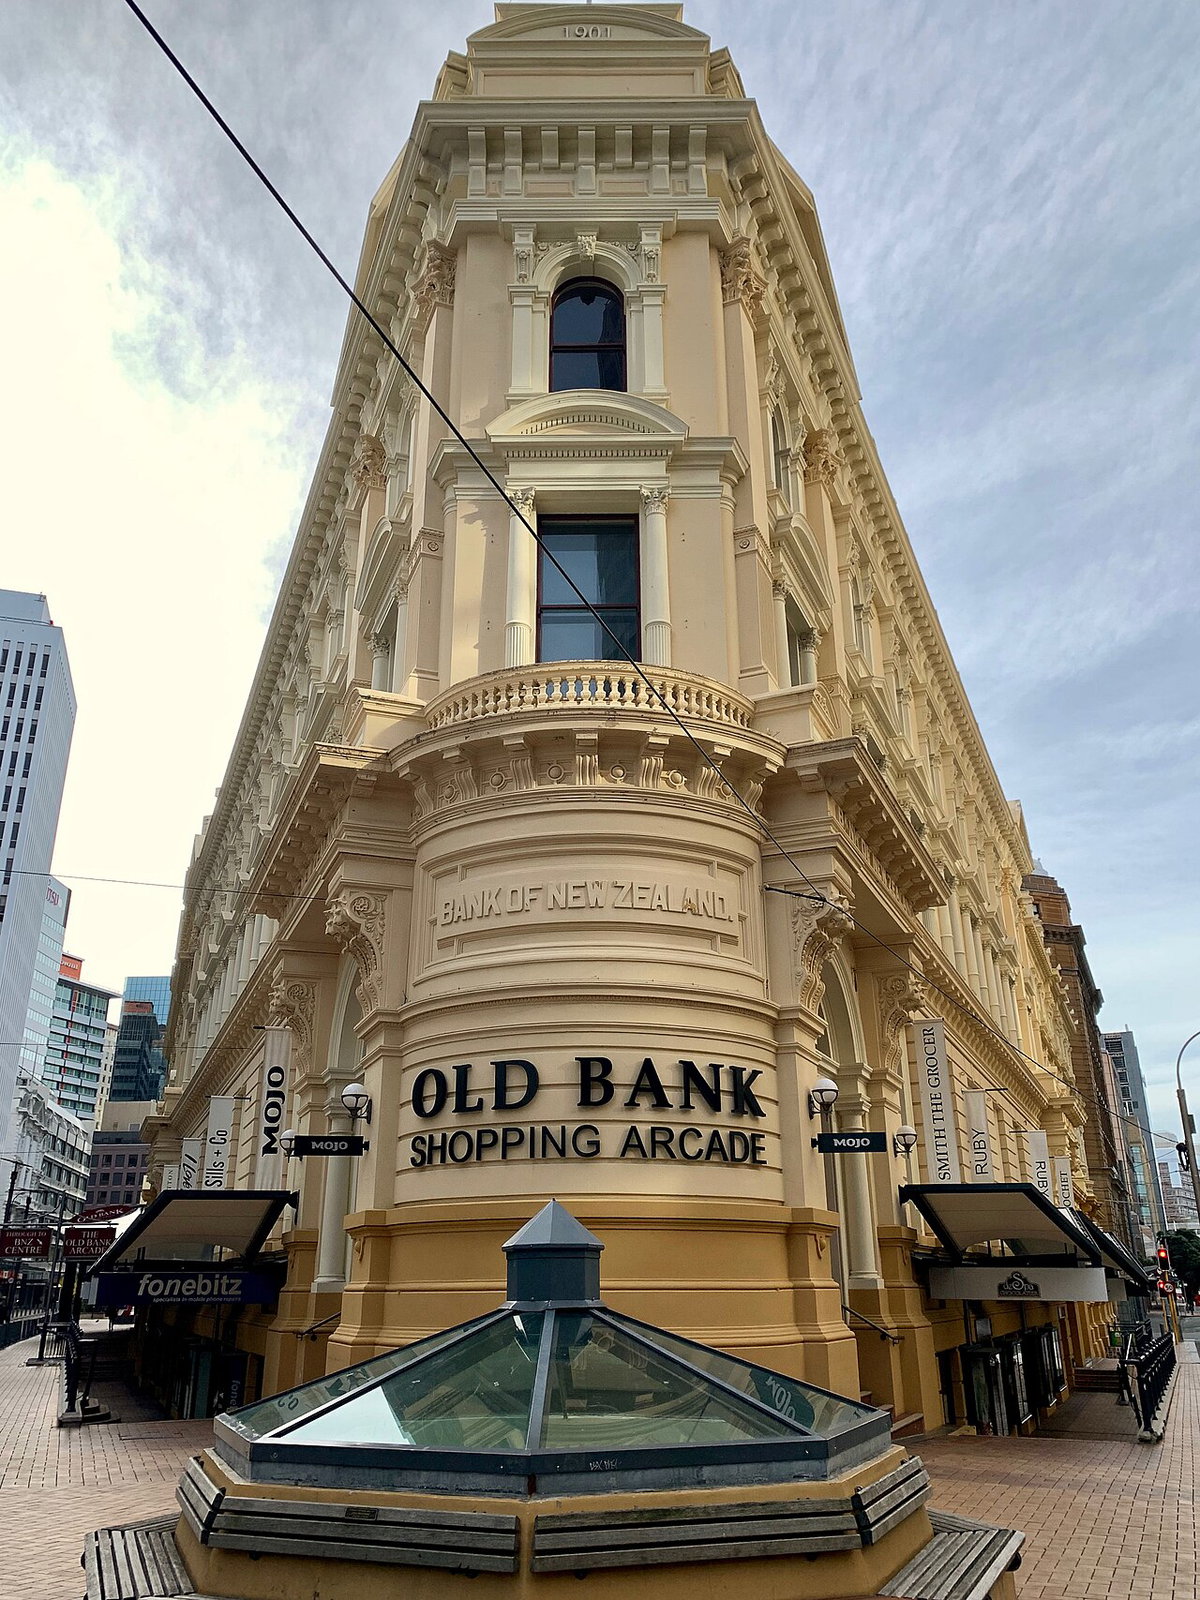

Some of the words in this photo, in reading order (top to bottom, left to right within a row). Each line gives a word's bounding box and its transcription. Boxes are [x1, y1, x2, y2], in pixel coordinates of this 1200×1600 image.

[563, 25, 612, 38] 1901
[440, 886, 501, 926] BANK
[507, 882, 543, 913] OF
[547, 880, 609, 911] NEW
[922, 1026, 941, 1088] GROCER
[411, 1058, 540, 1119] OLD
[574, 1056, 767, 1118] BANK
[261, 1065, 286, 1158] MOJO
[930, 1092, 945, 1125] THE
[208, 1130, 228, 1145] Co
[311, 1141, 349, 1151] MOJO
[410, 1124, 601, 1168] SHOPPING
[620, 1125, 768, 1166] ARCADE
[833, 1138, 871, 1148] MOJO
[933, 1127, 951, 1181] SMITH
[972, 1128, 989, 1175] RUBY
[205, 1161, 225, 1188] Sills
[1035, 1160, 1050, 1198] RUBY
[5, 1246, 42, 1254] CENTRE
[86, 1238, 112, 1247] BANK
[137, 1274, 242, 1296] fonebitz
